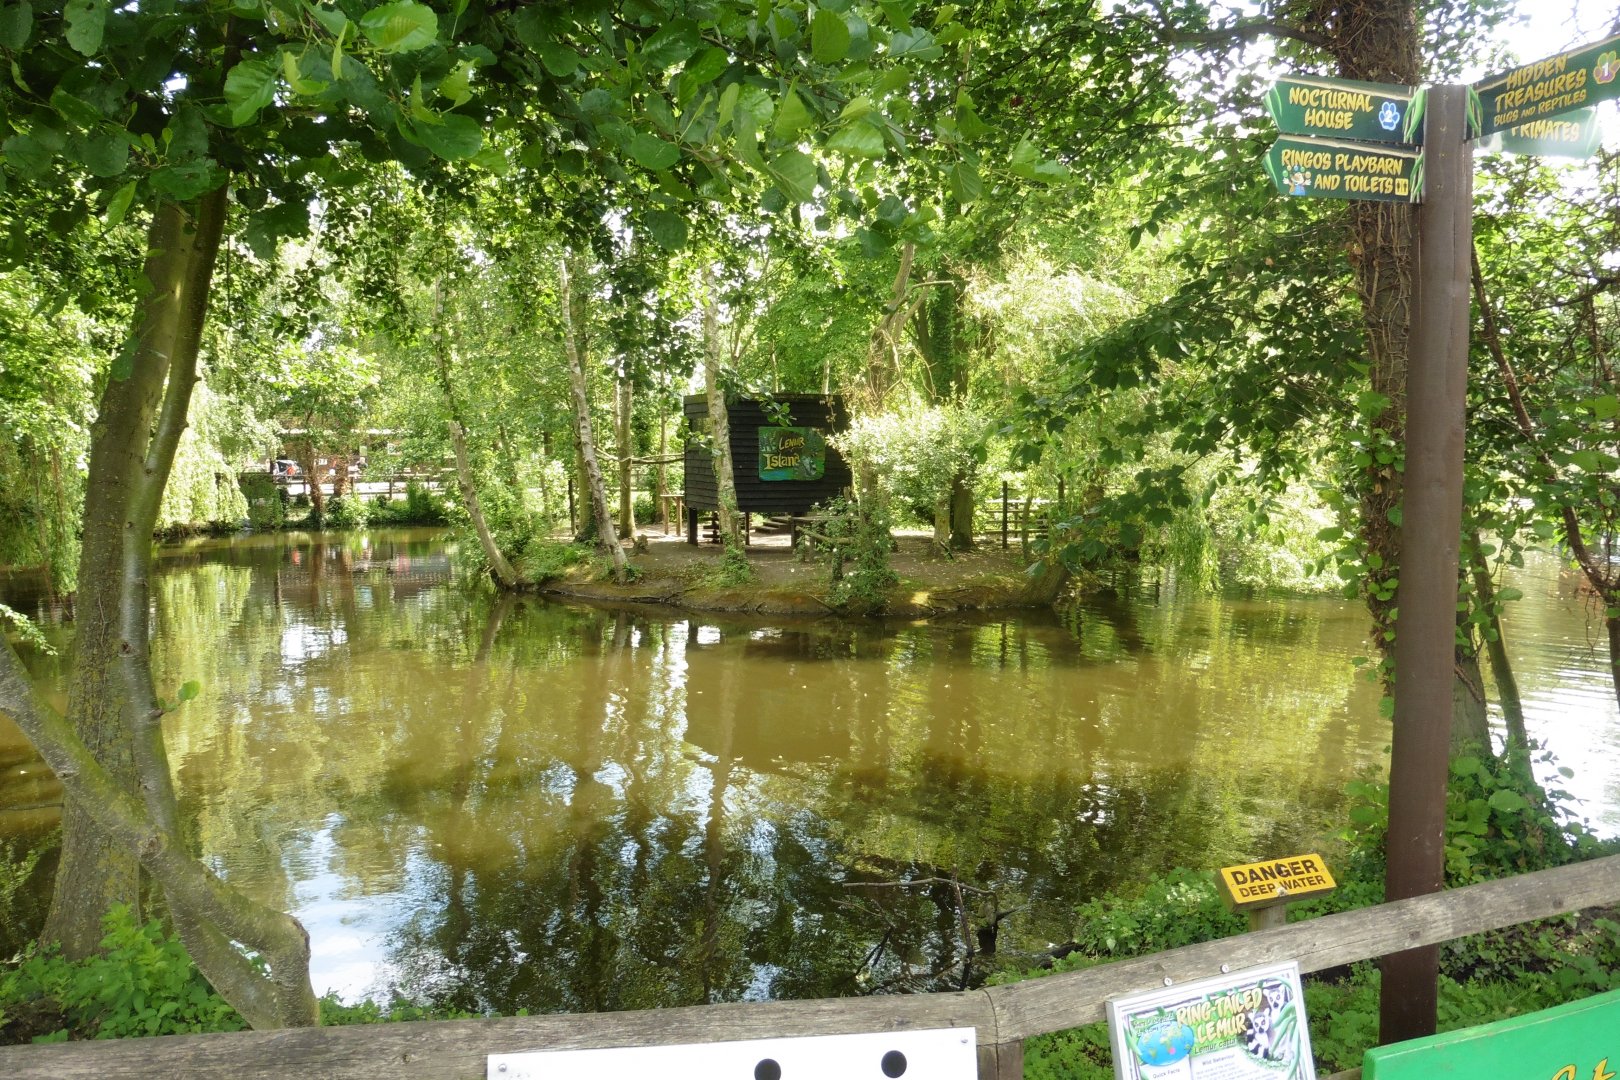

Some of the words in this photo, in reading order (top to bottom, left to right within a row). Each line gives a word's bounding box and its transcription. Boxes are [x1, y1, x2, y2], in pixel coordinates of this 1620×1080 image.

[1506, 54, 1568, 90] HIDDEN
[1289, 86, 1374, 112] NOCTURNAL
[1495, 68, 1587, 112] TREASURES
[1304, 108, 1354, 130] HOUSE
[1494, 109, 1519, 127] BUGS
[1521, 106, 1536, 118] AND
[1538, 89, 1587, 114] REPTILES
[1281, 149, 1332, 170] RINGO'S
[1335, 154, 1403, 176] PLAYBARN
[1314, 174, 1340, 191] AND
[1343, 175, 1394, 194] TOILETS
[763, 452, 800, 470] Island
[1231, 859, 1319, 885] DANGER
[1240, 883, 1276, 898] DEEP
[1279, 875, 1326, 890] WATER
[1177, 987, 1262, 1028] RING-TAILED
[1197, 1012, 1247, 1044] LEMUR
